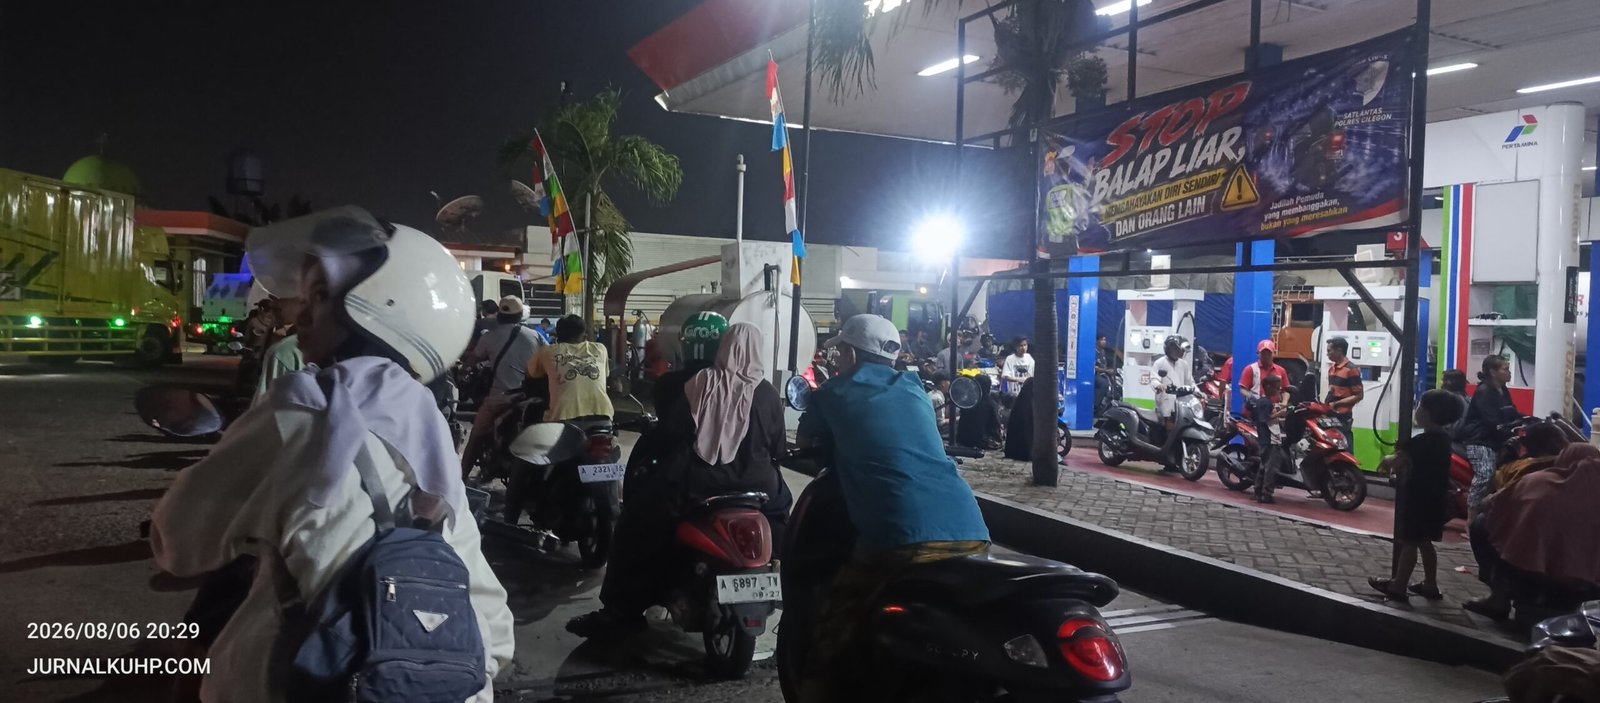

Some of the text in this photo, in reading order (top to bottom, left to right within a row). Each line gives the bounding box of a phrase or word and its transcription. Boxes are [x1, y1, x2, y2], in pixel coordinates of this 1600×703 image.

[1334, 113, 1392, 128] POLRES CILEGON
[1343, 107, 1383, 119] SATLANTAS
[1097, 81, 1253, 168] STOP
[1501, 141, 1539, 150] PERTAMINA
[1093, 126, 1245, 202] BALAP LIAR,
[1164, 185, 1182, 199] DIRI
[1182, 173, 1220, 194] SENDIRI
[1263, 198, 1340, 222] yang membanggakan,
[1269, 191, 1325, 210] Jadilah Pemuda
[1115, 195, 1206, 237] DAN ORANG LAIN
[1260, 206, 1348, 231] bukan yang meresahkan
[685, 324, 720, 341] Grab
[581, 467, 588, 475] A
[721, 579, 728, 589] A
[733, 577, 757, 589] 6897
